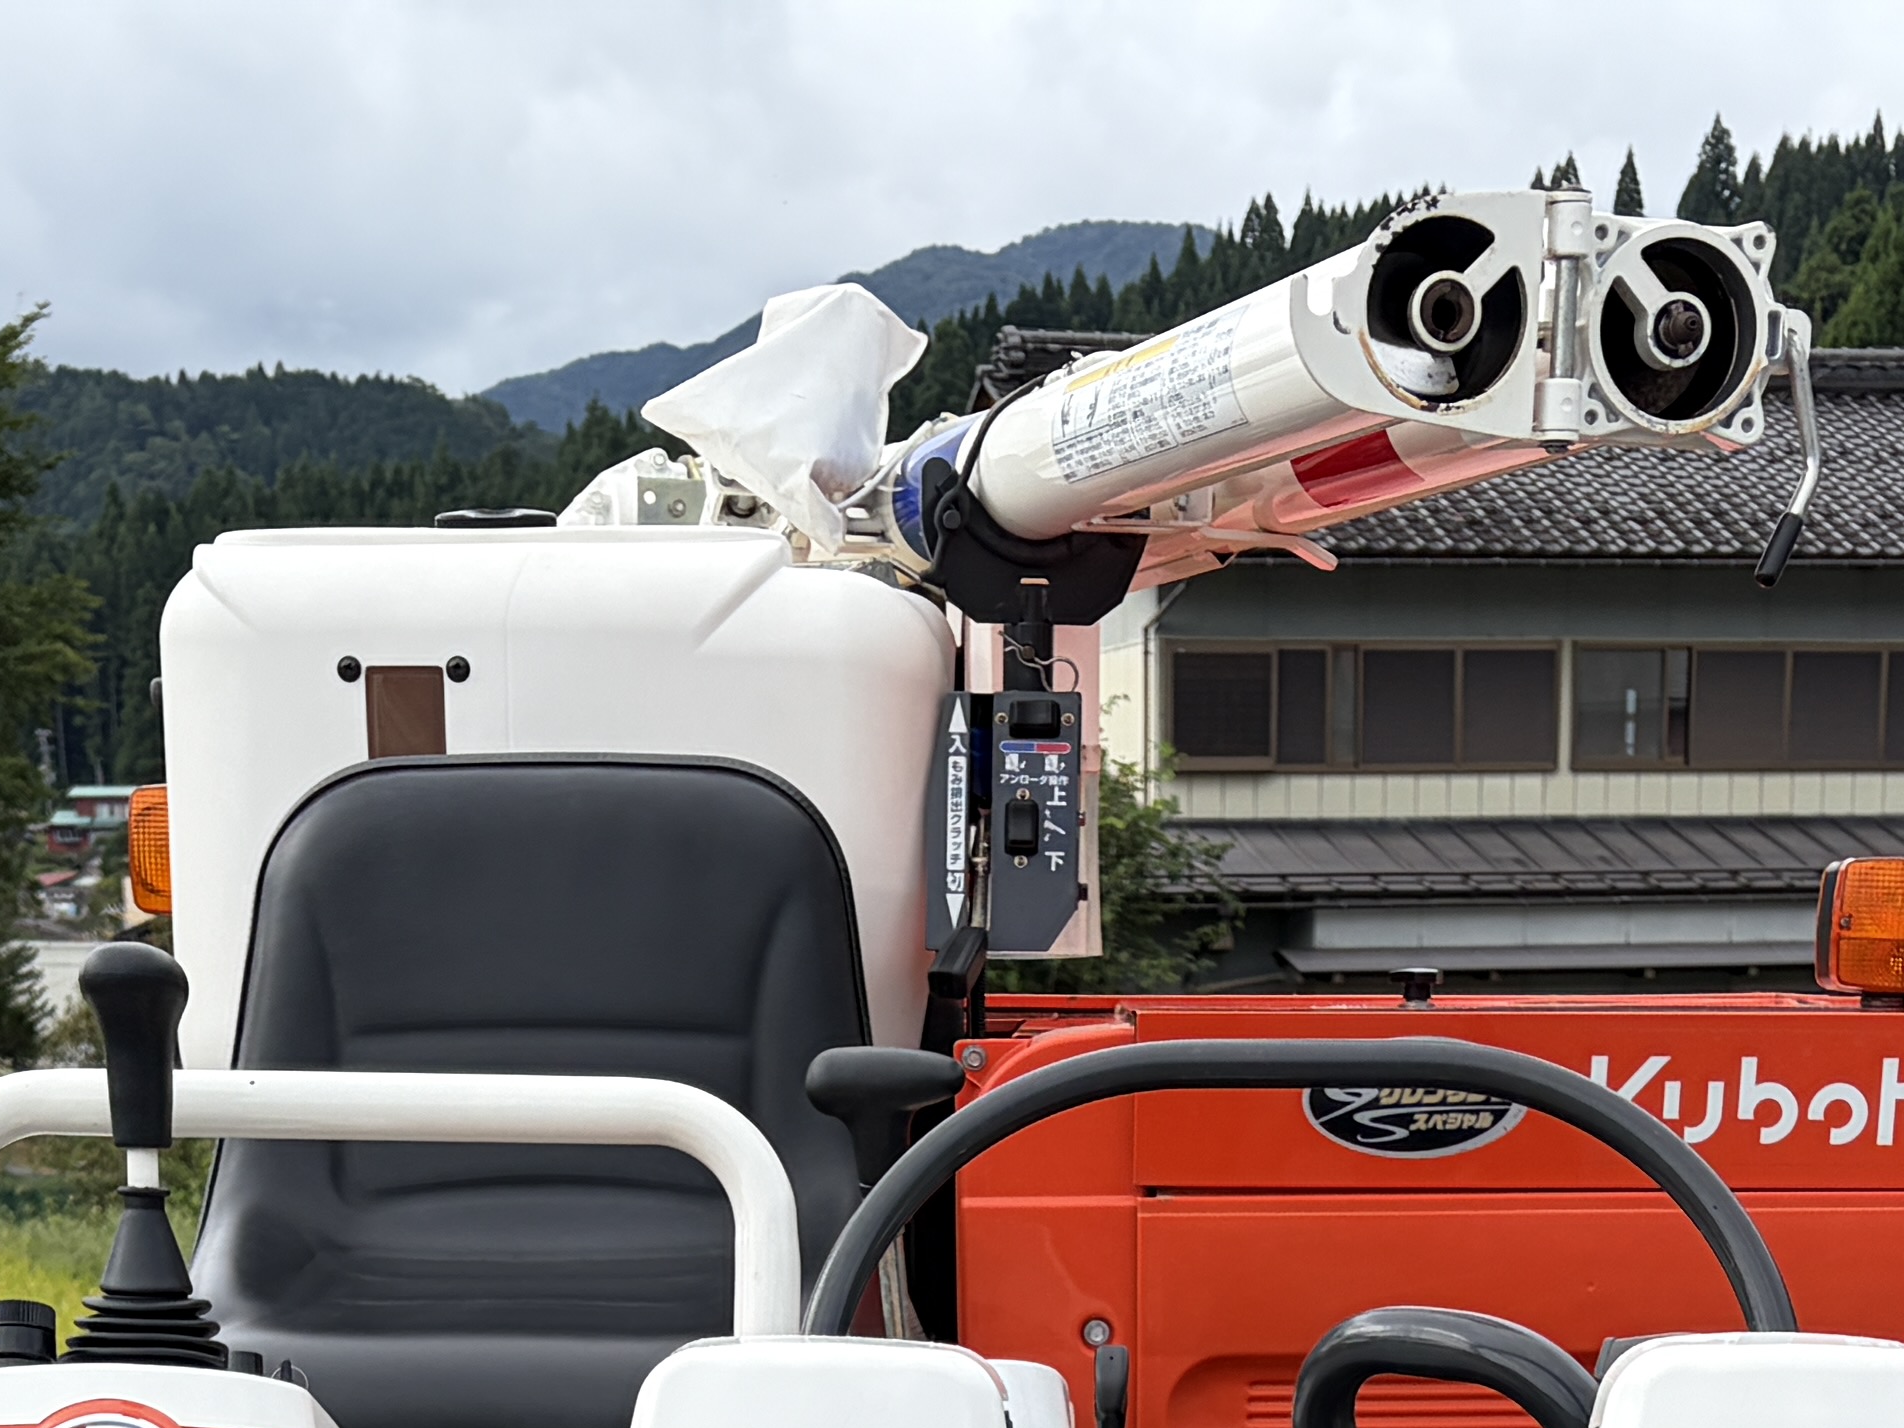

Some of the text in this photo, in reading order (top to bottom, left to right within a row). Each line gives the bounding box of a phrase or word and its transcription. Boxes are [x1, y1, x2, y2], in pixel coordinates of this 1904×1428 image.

[948, 735, 967, 753] 入
[1046, 786, 1067, 806] 上
[1044, 851, 1065, 872] 下
